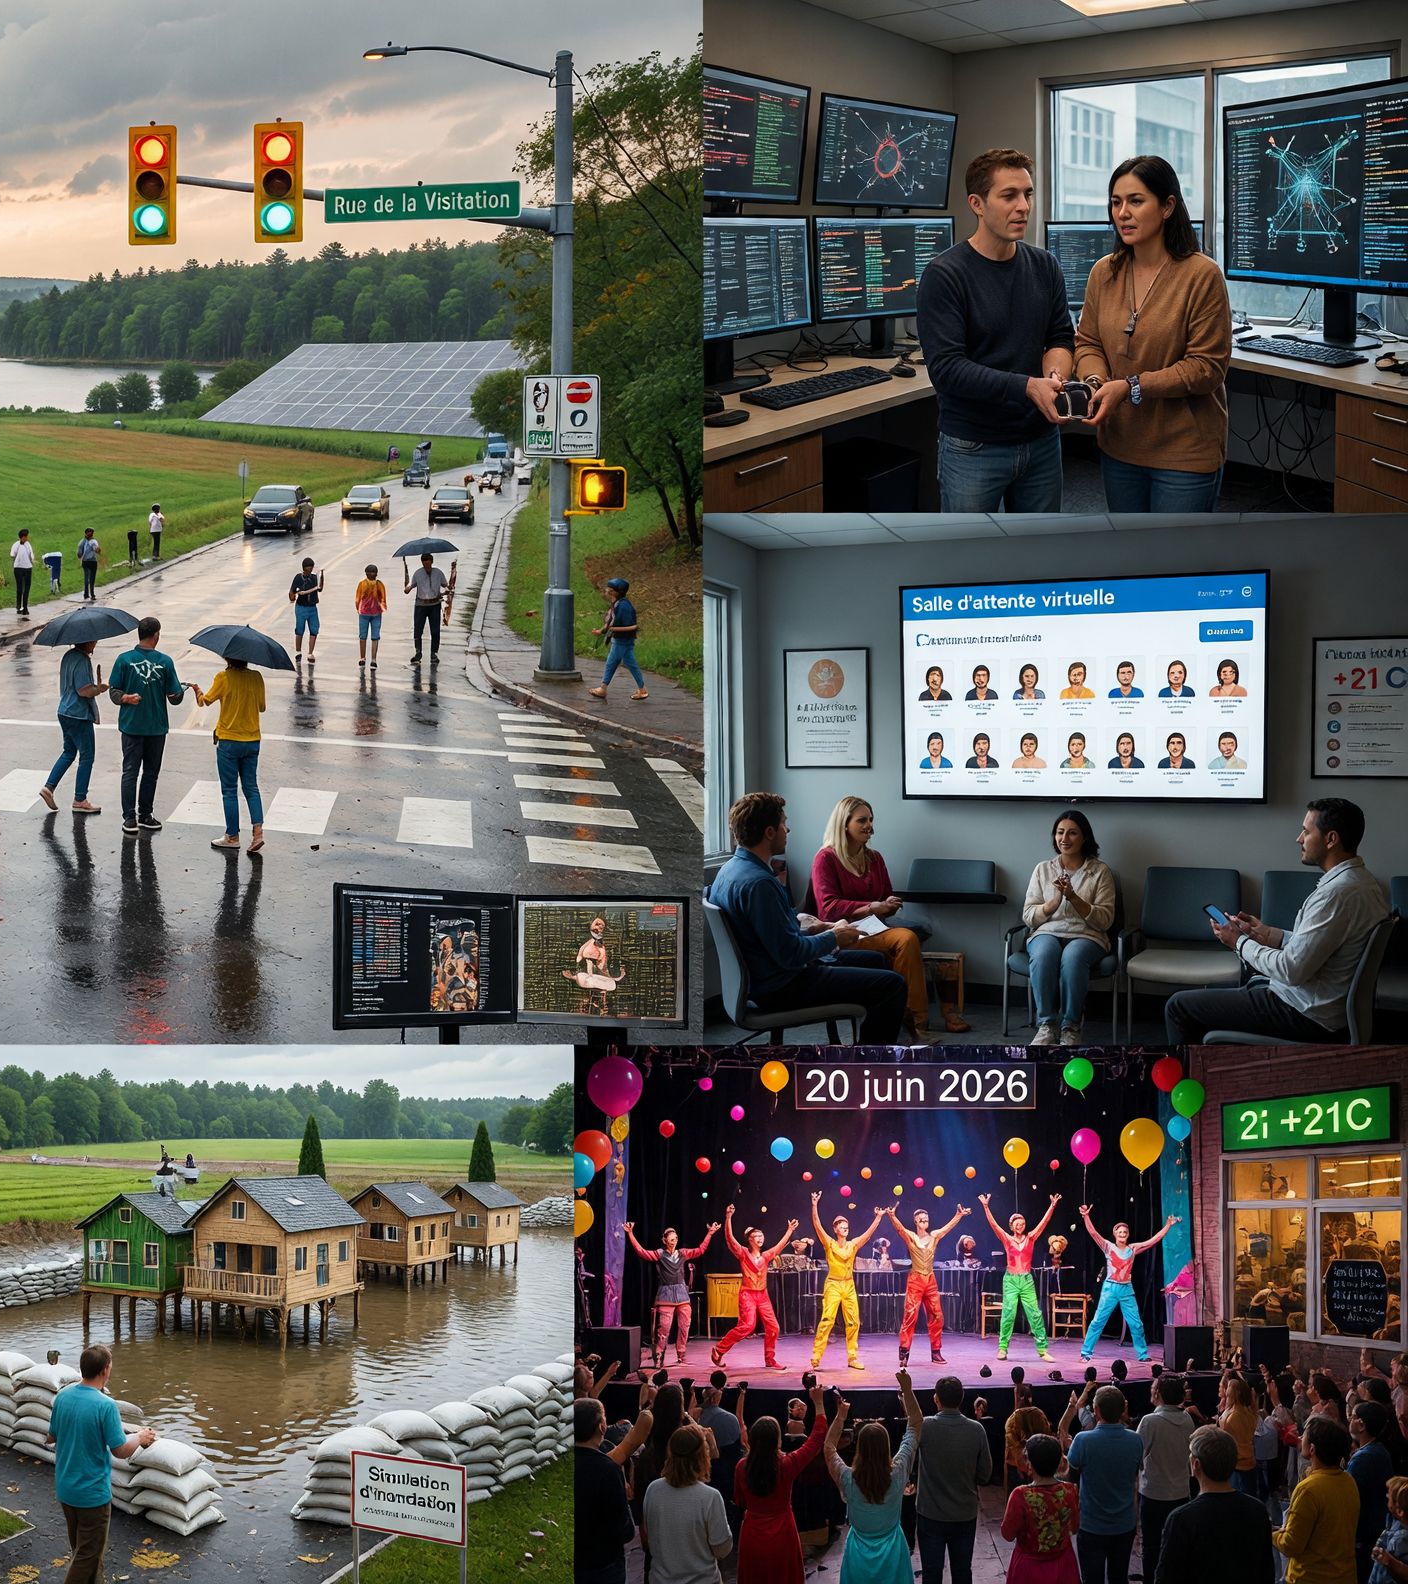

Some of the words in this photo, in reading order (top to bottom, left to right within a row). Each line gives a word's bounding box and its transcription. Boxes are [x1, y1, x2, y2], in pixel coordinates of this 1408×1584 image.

[334, 196, 366, 214] Rue
[374, 195, 394, 213] de
[402, 193, 417, 212] la
[424, 190, 510, 211] Visitation
[912, 595, 954, 613] Salle
[958, 592, 1036, 611] d'attente
[1041, 588, 1115, 606] virtuelle
[1239, 1109, 1269, 1141] 2i
[1280, 1098, 1373, 1136] +21C
[368, 1466, 450, 1492] Simulation
